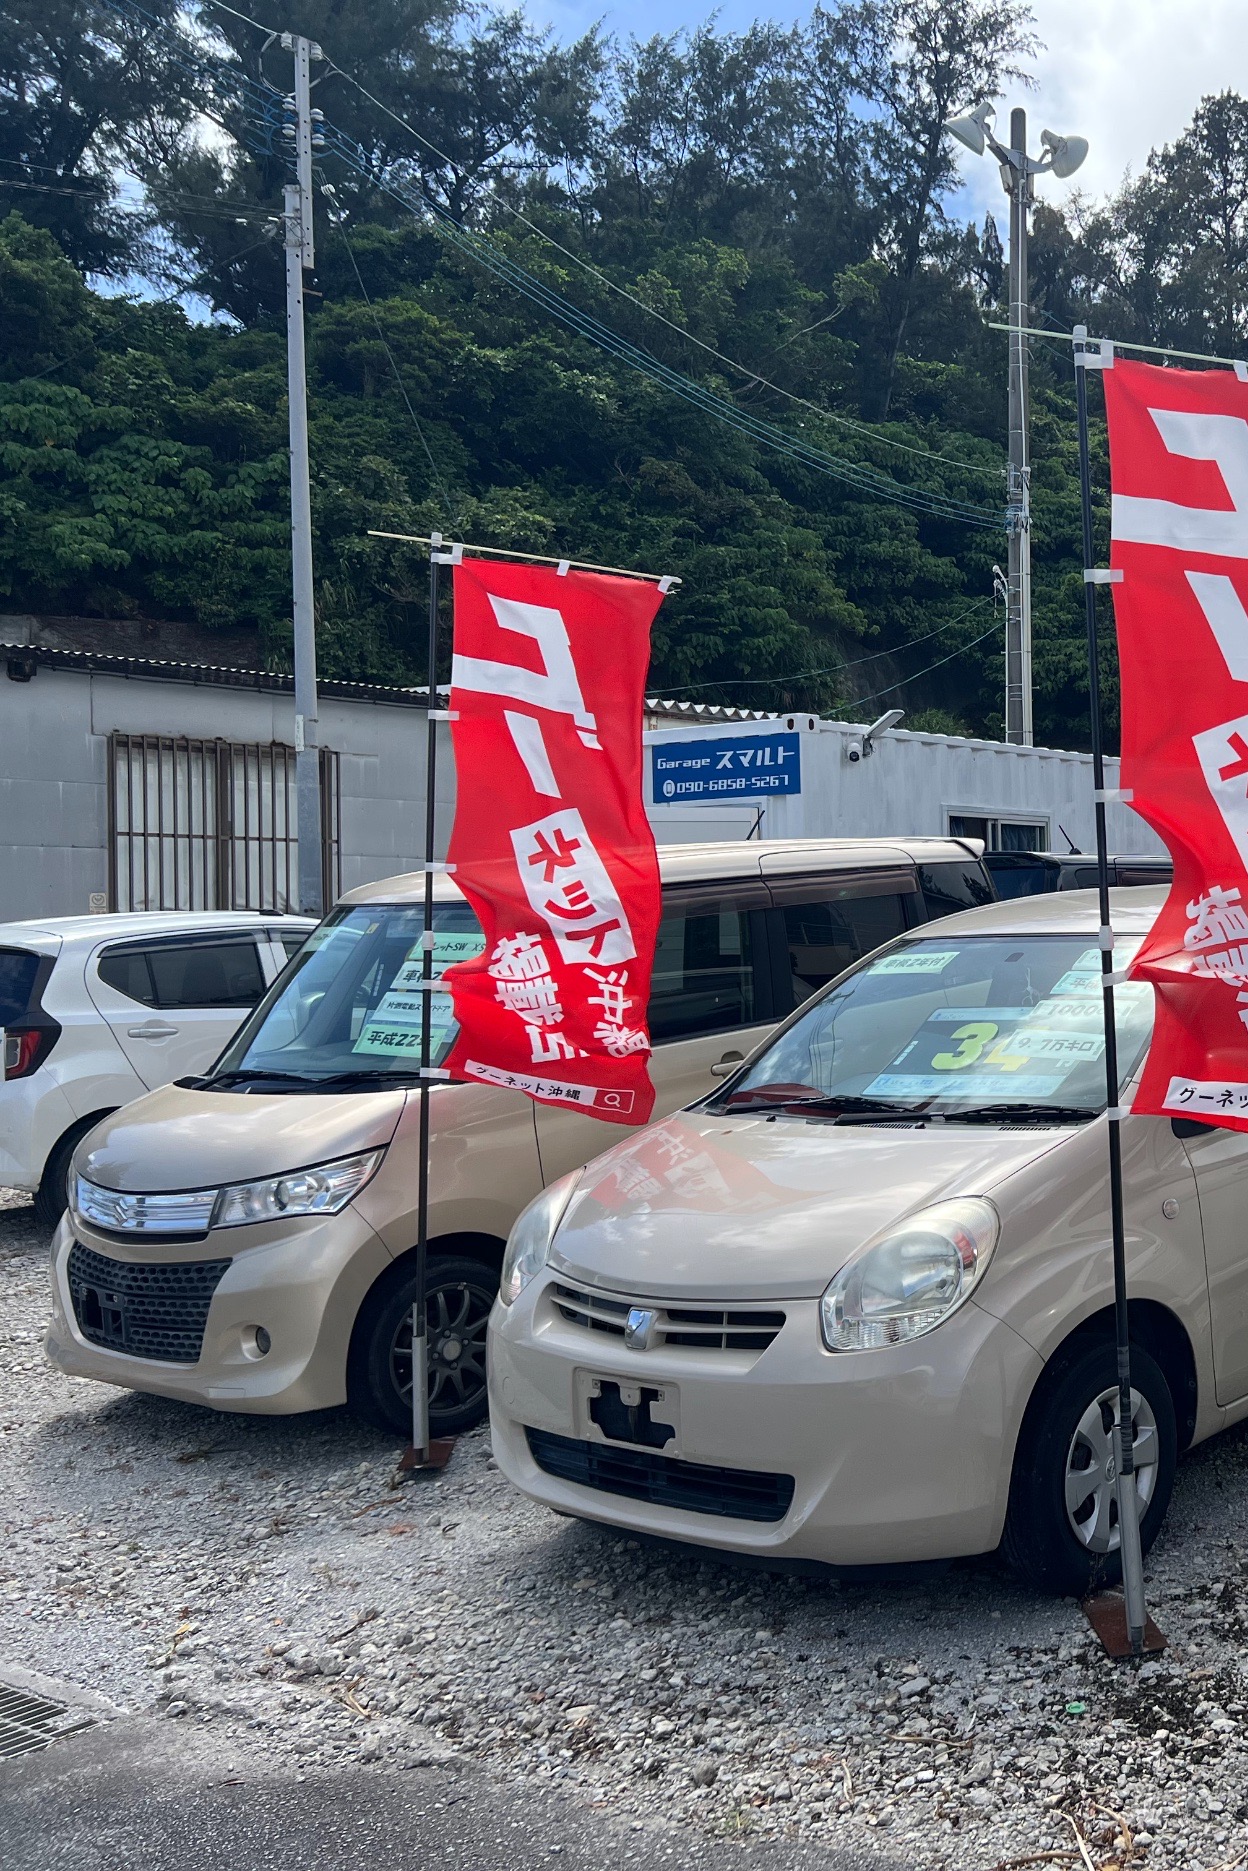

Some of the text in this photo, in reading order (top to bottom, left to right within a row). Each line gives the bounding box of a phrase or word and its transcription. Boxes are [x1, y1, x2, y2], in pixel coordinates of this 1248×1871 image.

[657, 746, 795, 769] Garage スマルト
[676, 774, 789, 794] 090-6858-5267
[883, 955, 947, 969] 車検2年付
[475, 1066, 582, 1101] グーネット沖縄
